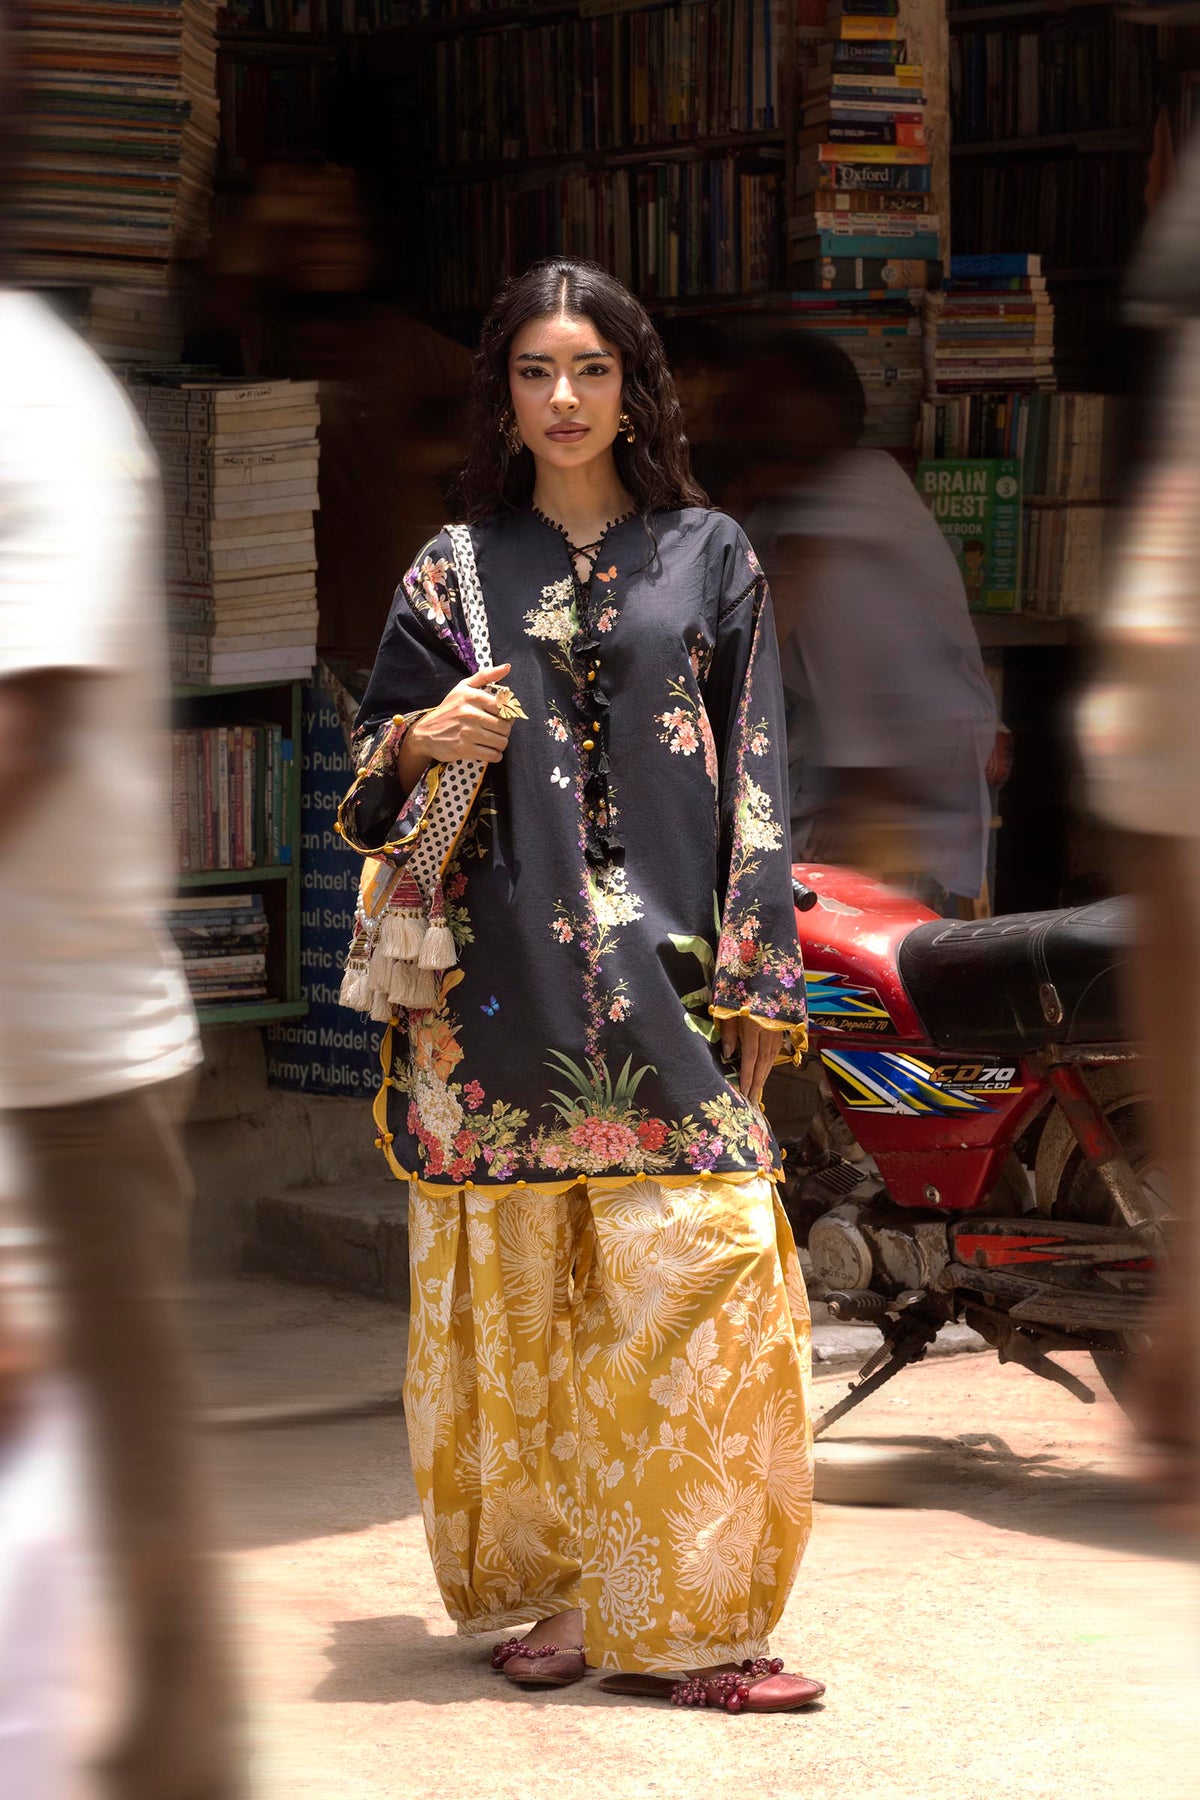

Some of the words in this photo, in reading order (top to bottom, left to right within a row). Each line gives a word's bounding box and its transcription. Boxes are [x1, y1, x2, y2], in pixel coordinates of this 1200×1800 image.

[841, 166, 890, 182] Oxford
[924, 470, 988, 494] BRAIN
[931, 494, 988, 518] UEST
[313, 752, 354, 772] Publi
[323, 908, 353, 929] Sch
[839, 1019, 875, 1031] Deposit
[876, 1020, 889, 1031] 70
[268, 1022, 317, 1046] Bharia
[320, 1027, 368, 1051] Model
[268, 1059, 310, 1088] Army
[312, 1062, 360, 1086] Public
[984, 1082, 1011, 1090] CDI
